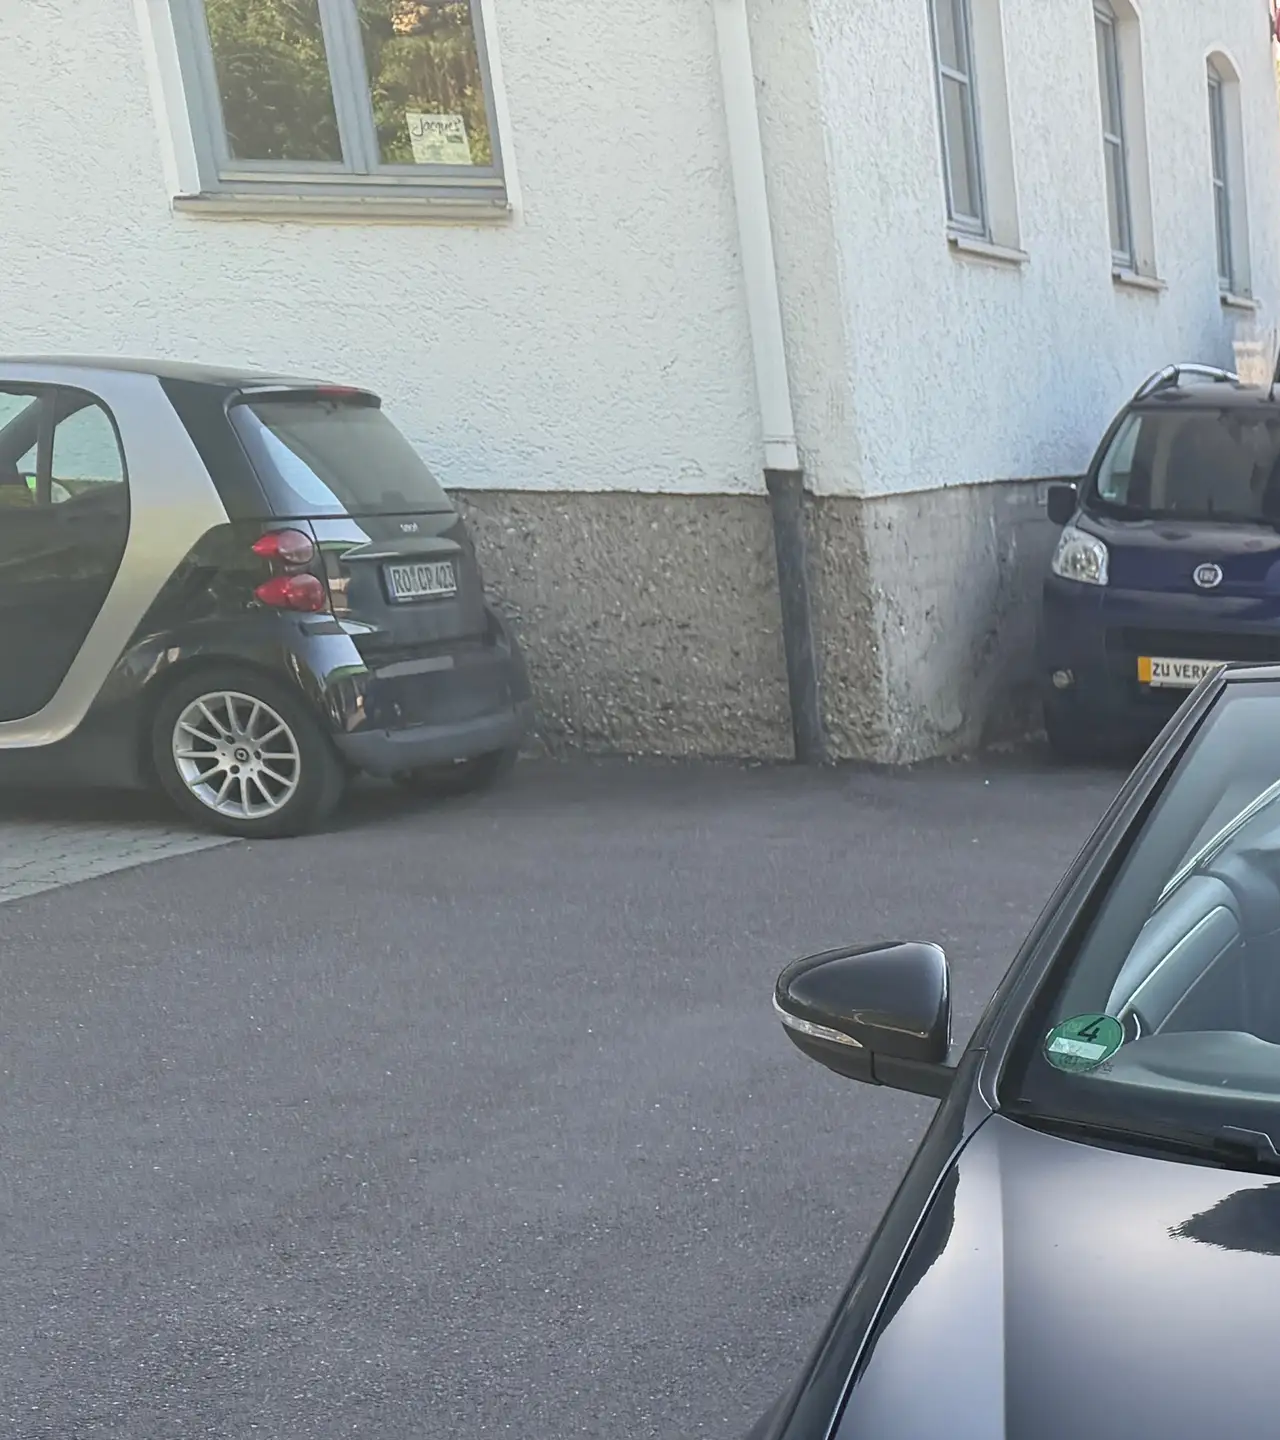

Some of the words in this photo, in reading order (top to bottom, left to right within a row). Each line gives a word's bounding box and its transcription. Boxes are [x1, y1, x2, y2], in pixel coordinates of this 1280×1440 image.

[392, 568, 412, 594] RO
[1153, 663, 1170, 677] ZU
[1077, 1016, 1105, 1042] 4
